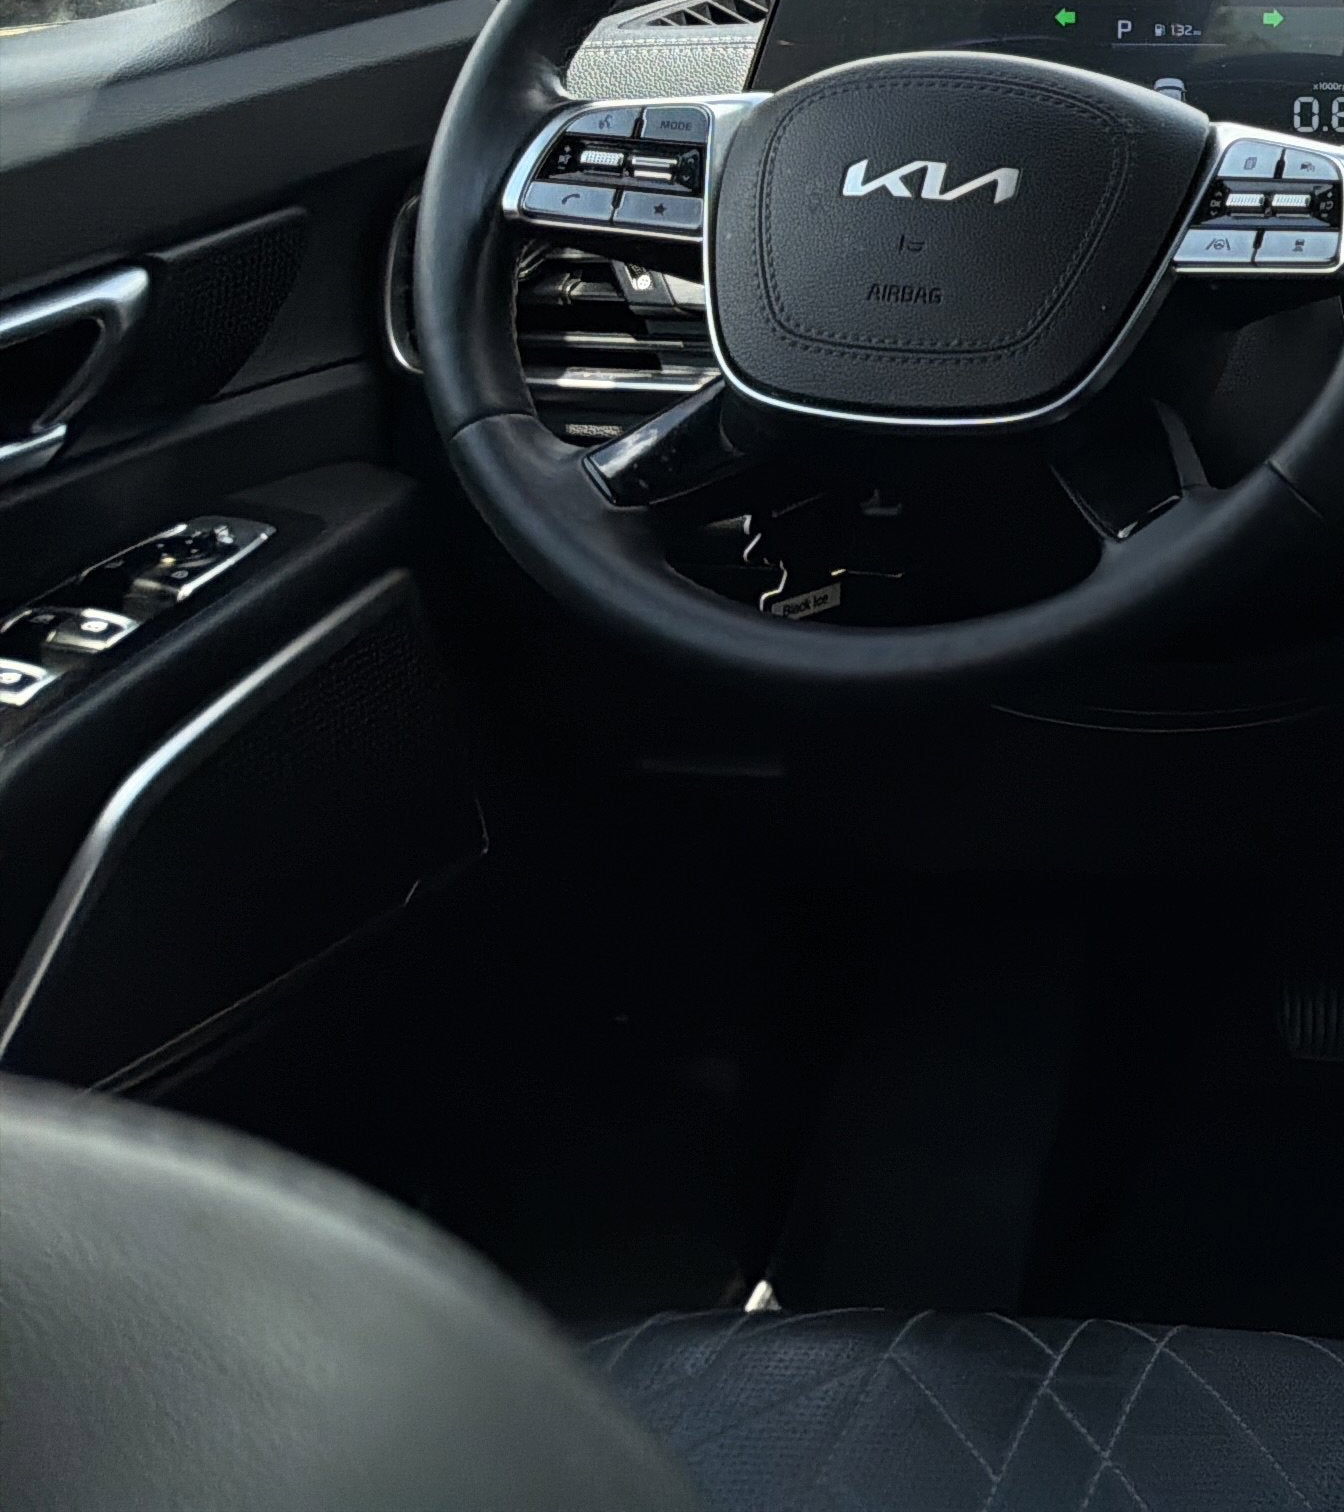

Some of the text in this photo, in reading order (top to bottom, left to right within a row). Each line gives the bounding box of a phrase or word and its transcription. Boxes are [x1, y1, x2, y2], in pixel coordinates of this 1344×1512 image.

[1117, 20, 1132, 39] P
[1170, 24, 1193, 36] 132
[842, 158, 1020, 204] KIA
[866, 282, 942, 305] AIRBAG
